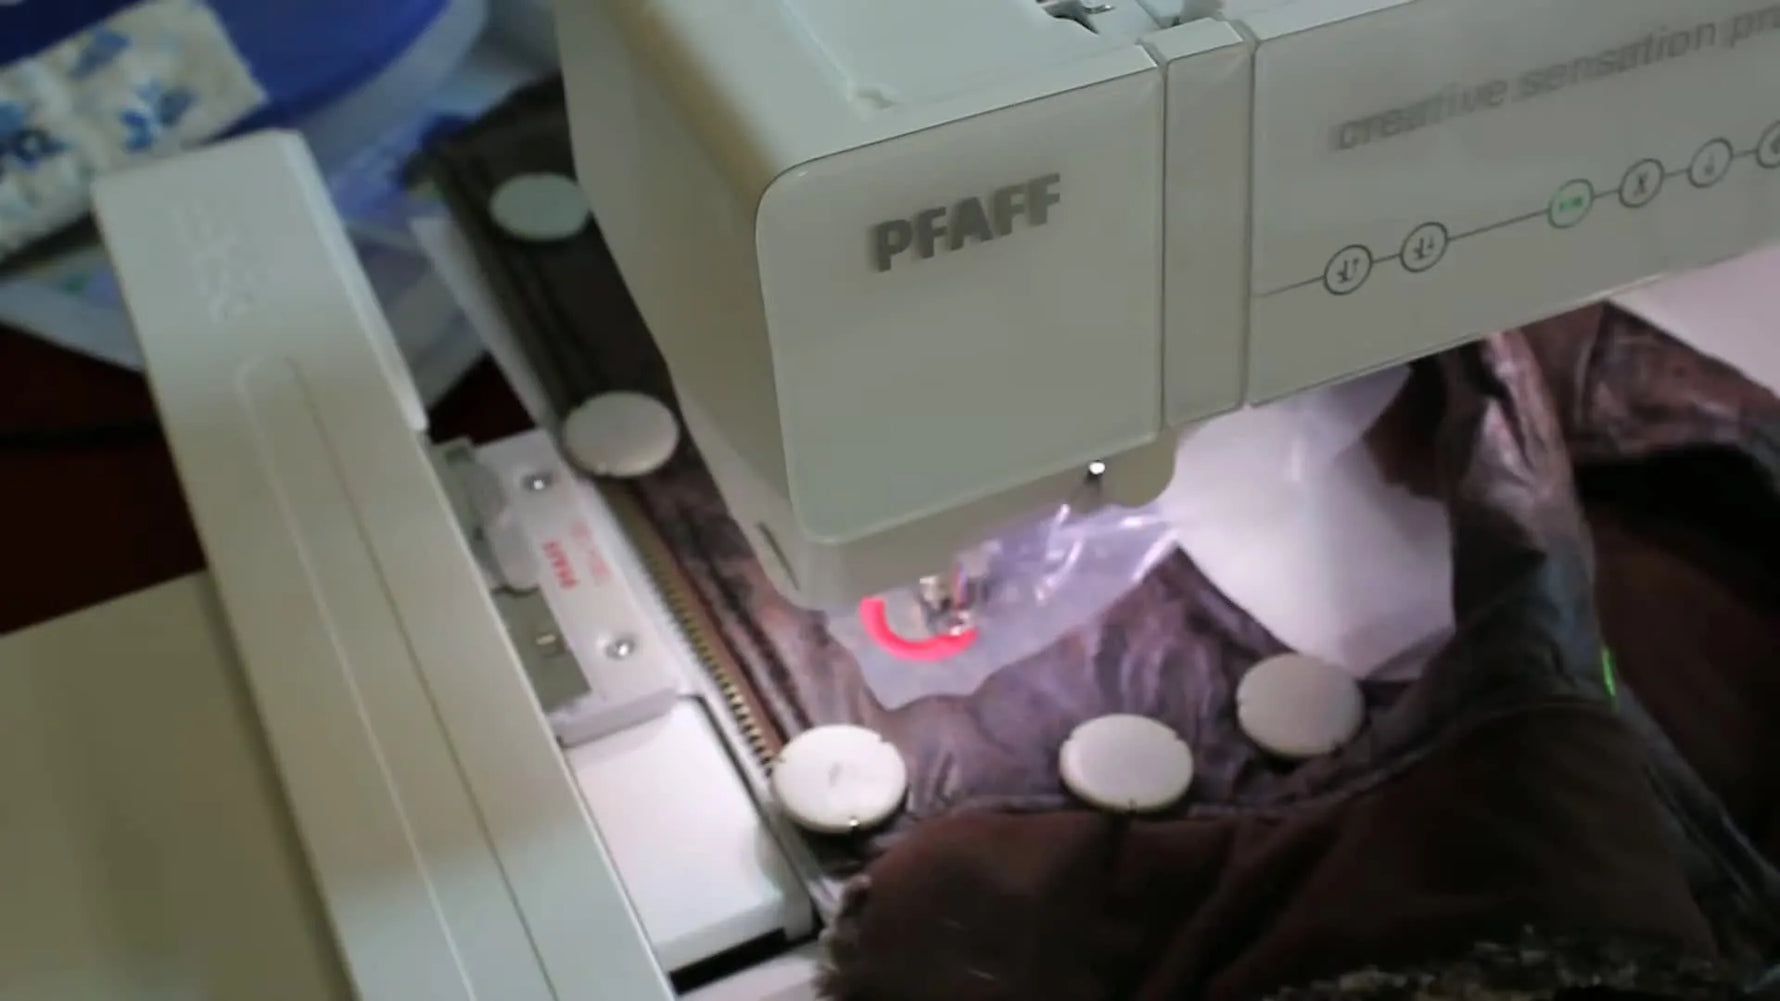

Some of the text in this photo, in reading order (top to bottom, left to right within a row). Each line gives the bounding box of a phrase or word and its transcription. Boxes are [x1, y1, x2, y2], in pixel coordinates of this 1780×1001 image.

[1330, 76, 1510, 153] creative
[1516, 21, 1717, 97] sensation
[868, 172, 1061, 273] PFAFF
